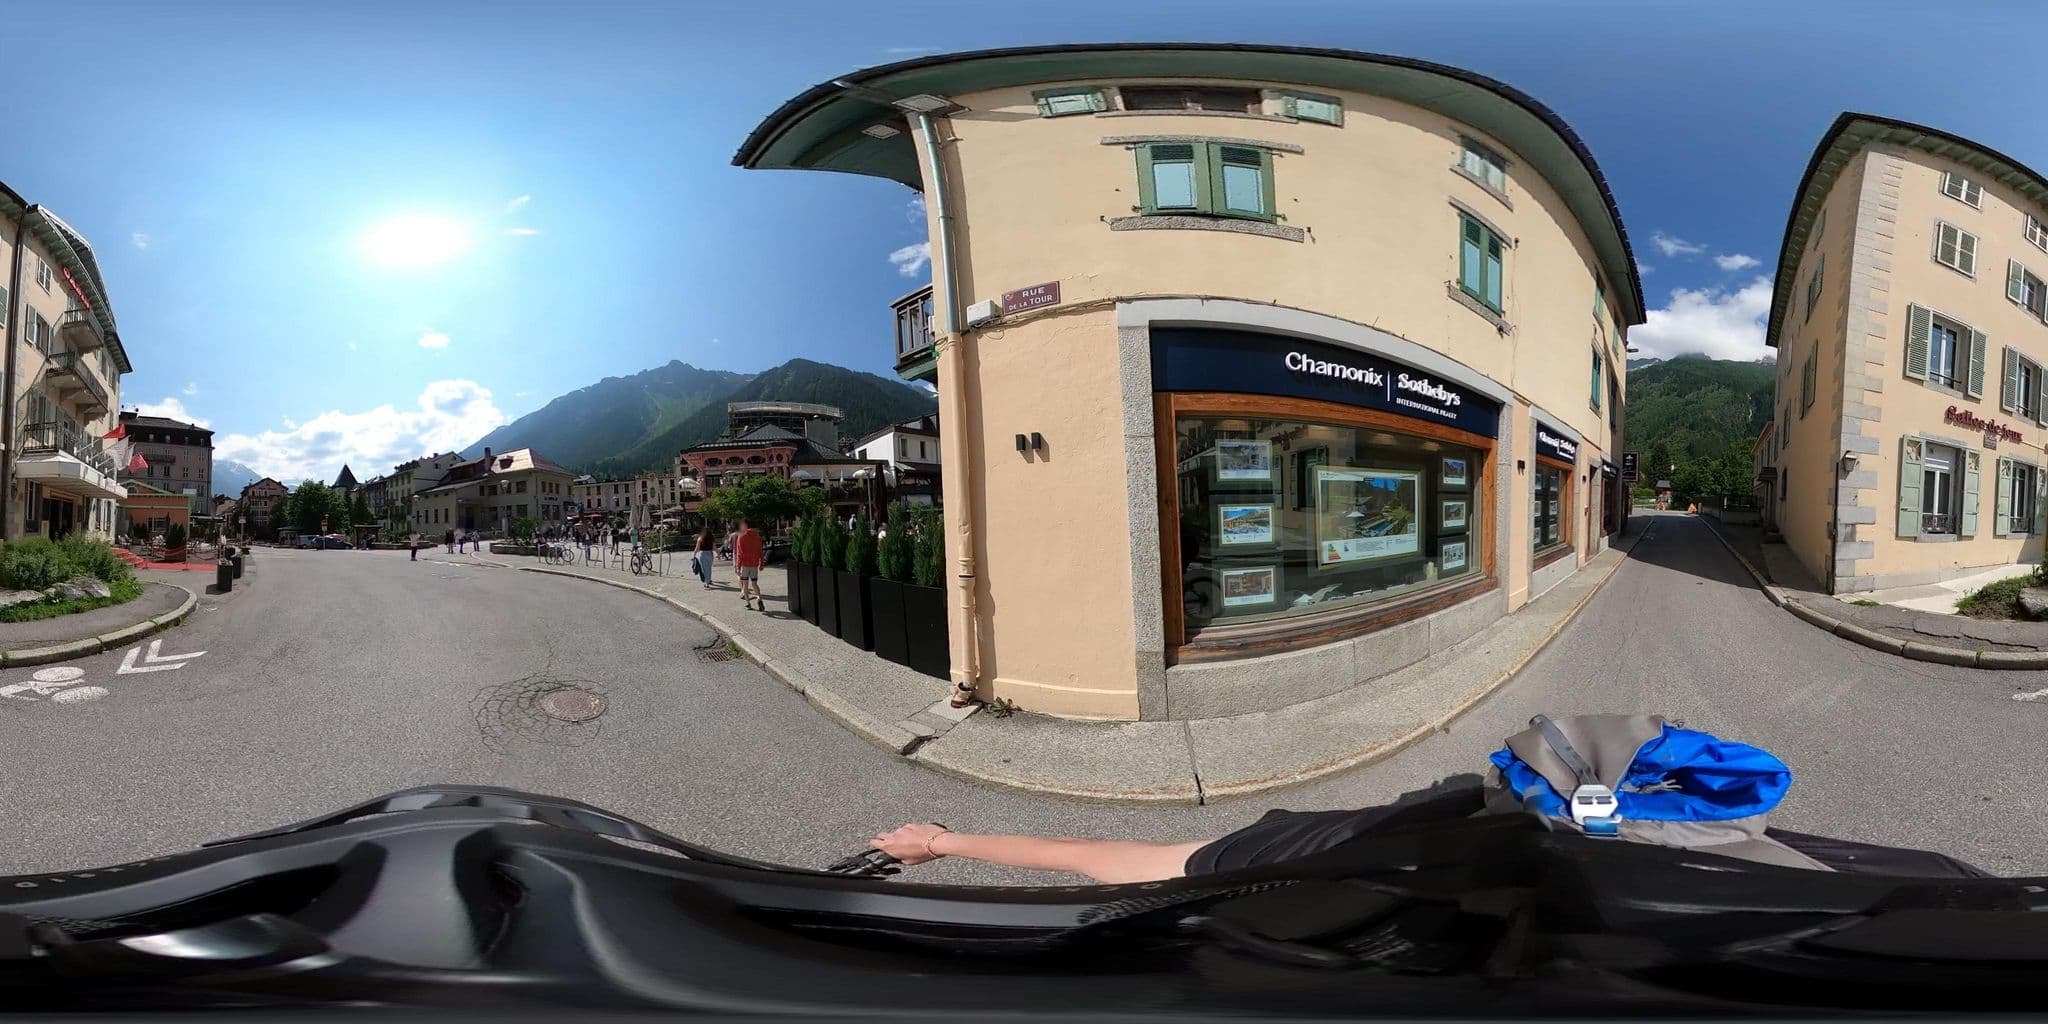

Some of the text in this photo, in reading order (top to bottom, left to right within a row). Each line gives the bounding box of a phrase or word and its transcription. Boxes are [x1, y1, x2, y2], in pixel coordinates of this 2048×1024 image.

[1022, 286, 1045, 298] RUE
[1029, 294, 1052, 305] TOUR
[1285, 351, 1384, 387] Chamonix
